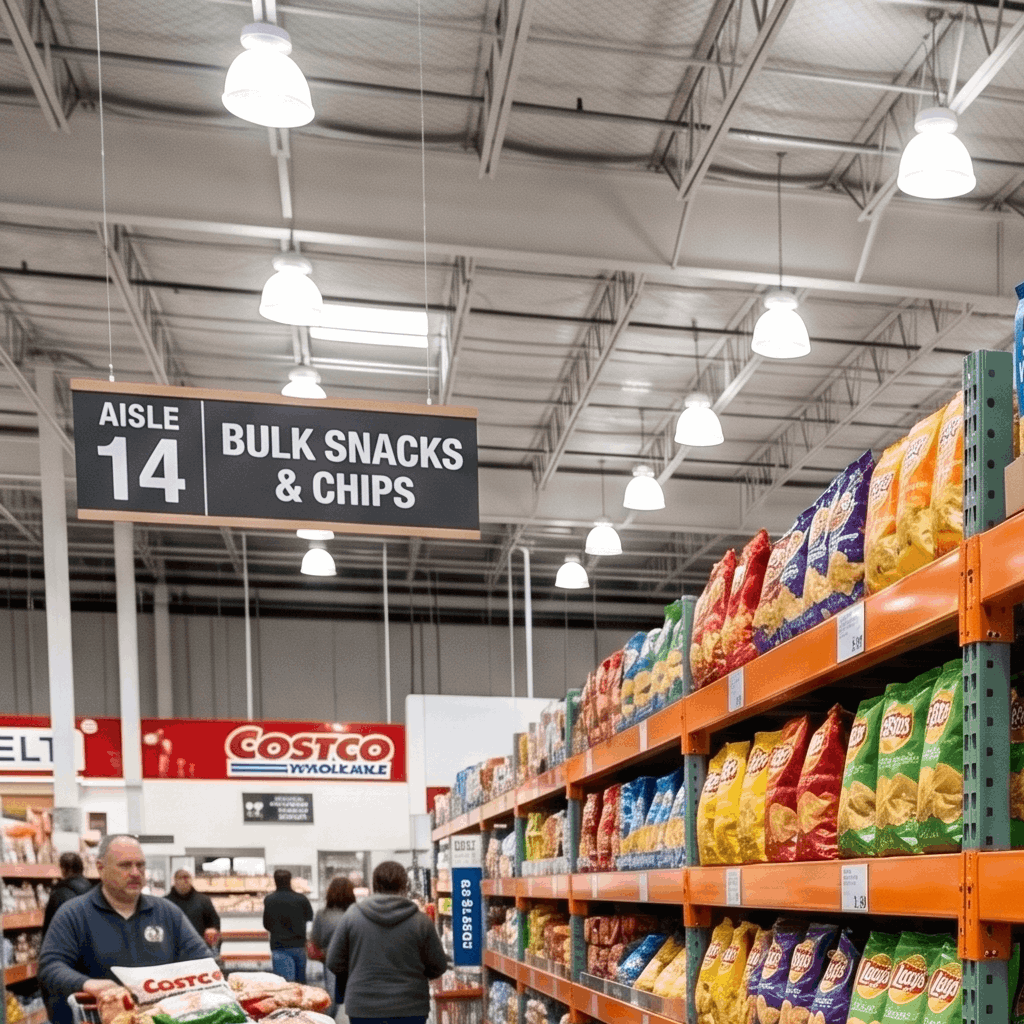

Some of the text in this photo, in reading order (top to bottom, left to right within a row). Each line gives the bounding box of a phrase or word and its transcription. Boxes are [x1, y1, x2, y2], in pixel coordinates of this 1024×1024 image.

[99, 402, 180, 431] AISLE
[222, 422, 464, 471] BULK SNACKS
[97, 436, 186, 503] 14
[275, 468, 416, 509] & CHIPS
[228, 727, 393, 763] COSTCO
